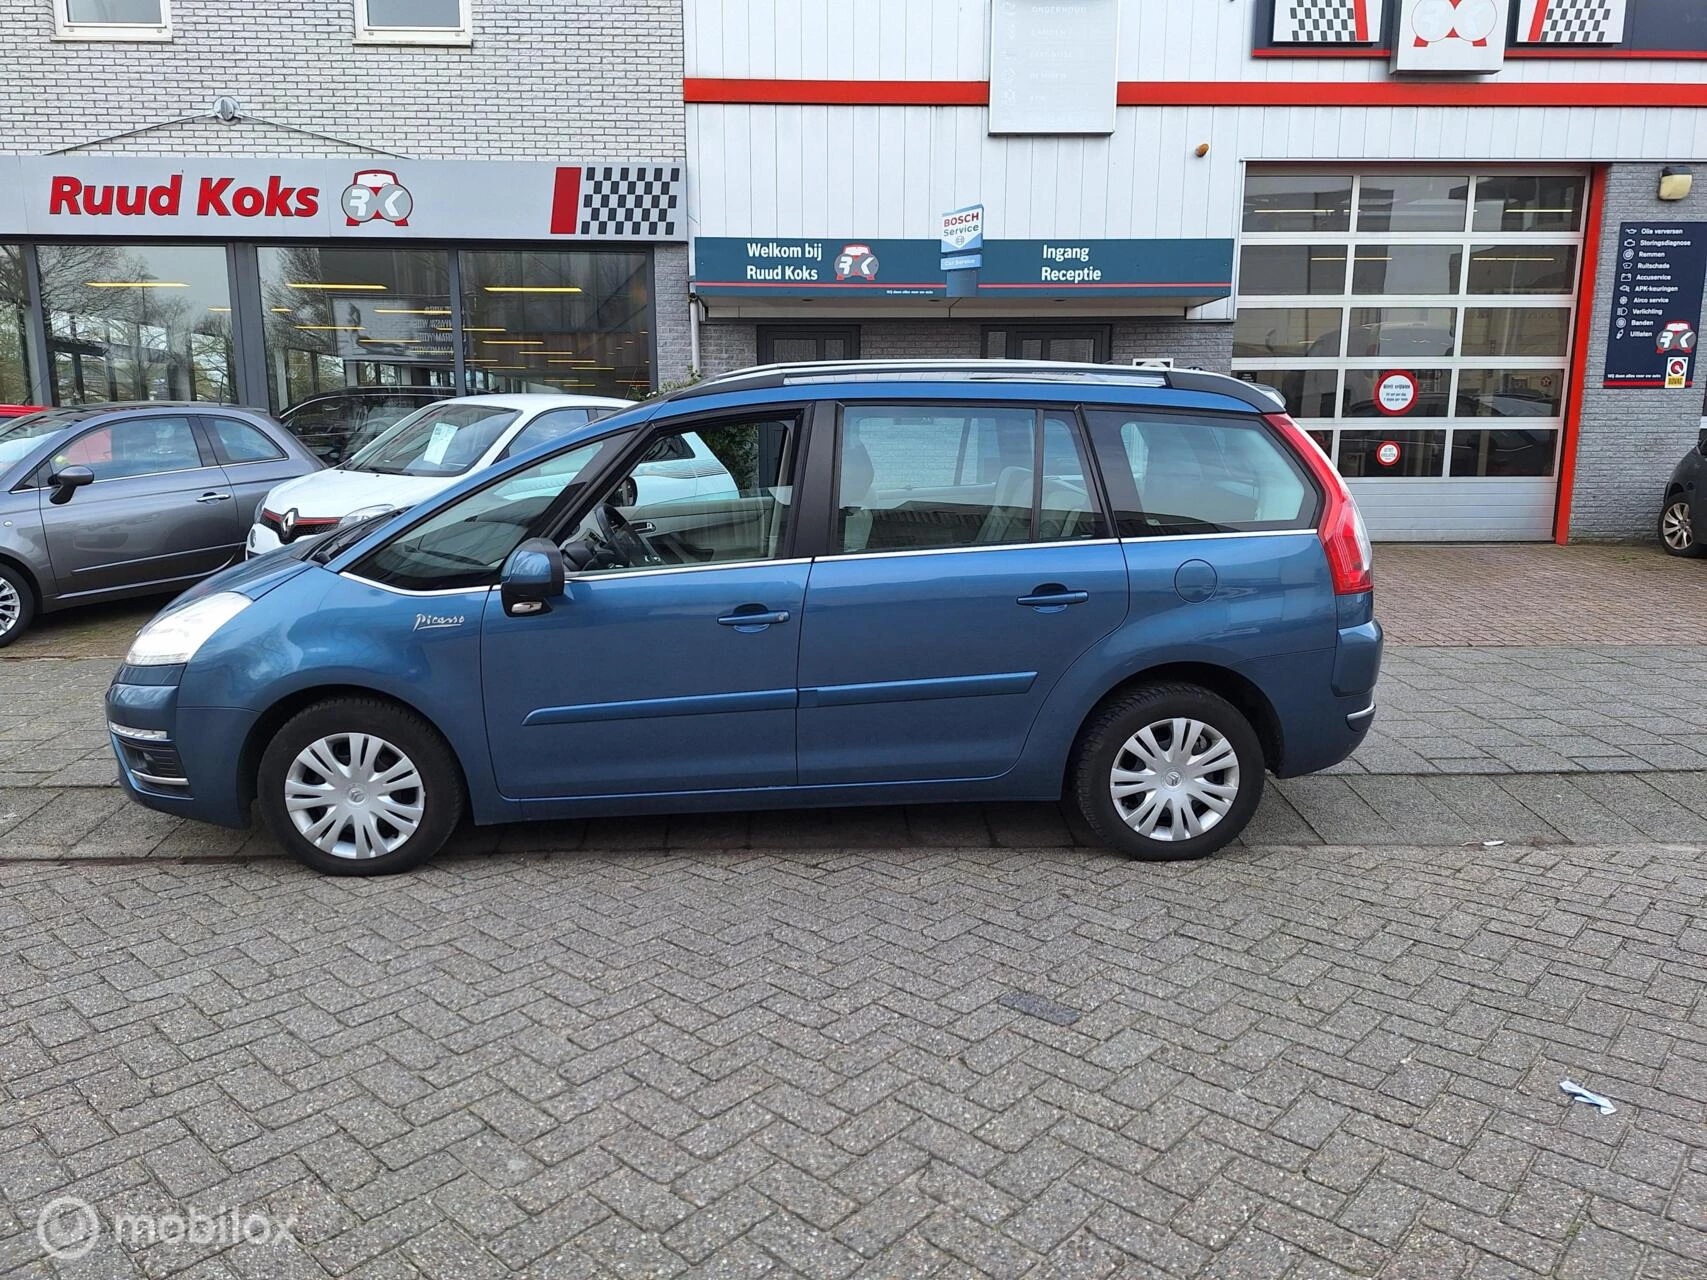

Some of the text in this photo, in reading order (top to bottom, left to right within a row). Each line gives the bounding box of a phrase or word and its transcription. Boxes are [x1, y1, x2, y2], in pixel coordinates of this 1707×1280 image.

[49, 174, 320, 217] Ruud Koks
[943, 211, 980, 228] BOSCH
[943, 224, 980, 237] Service
[747, 243, 822, 261] Welkom bij
[1042, 244, 1090, 262] Ingang
[746, 265, 818, 281] Ruud Koks
[1041, 267, 1102, 284] Receptie
[1632, 308, 1663, 316] Verlichting
[413, 613, 465, 633] Picasso
